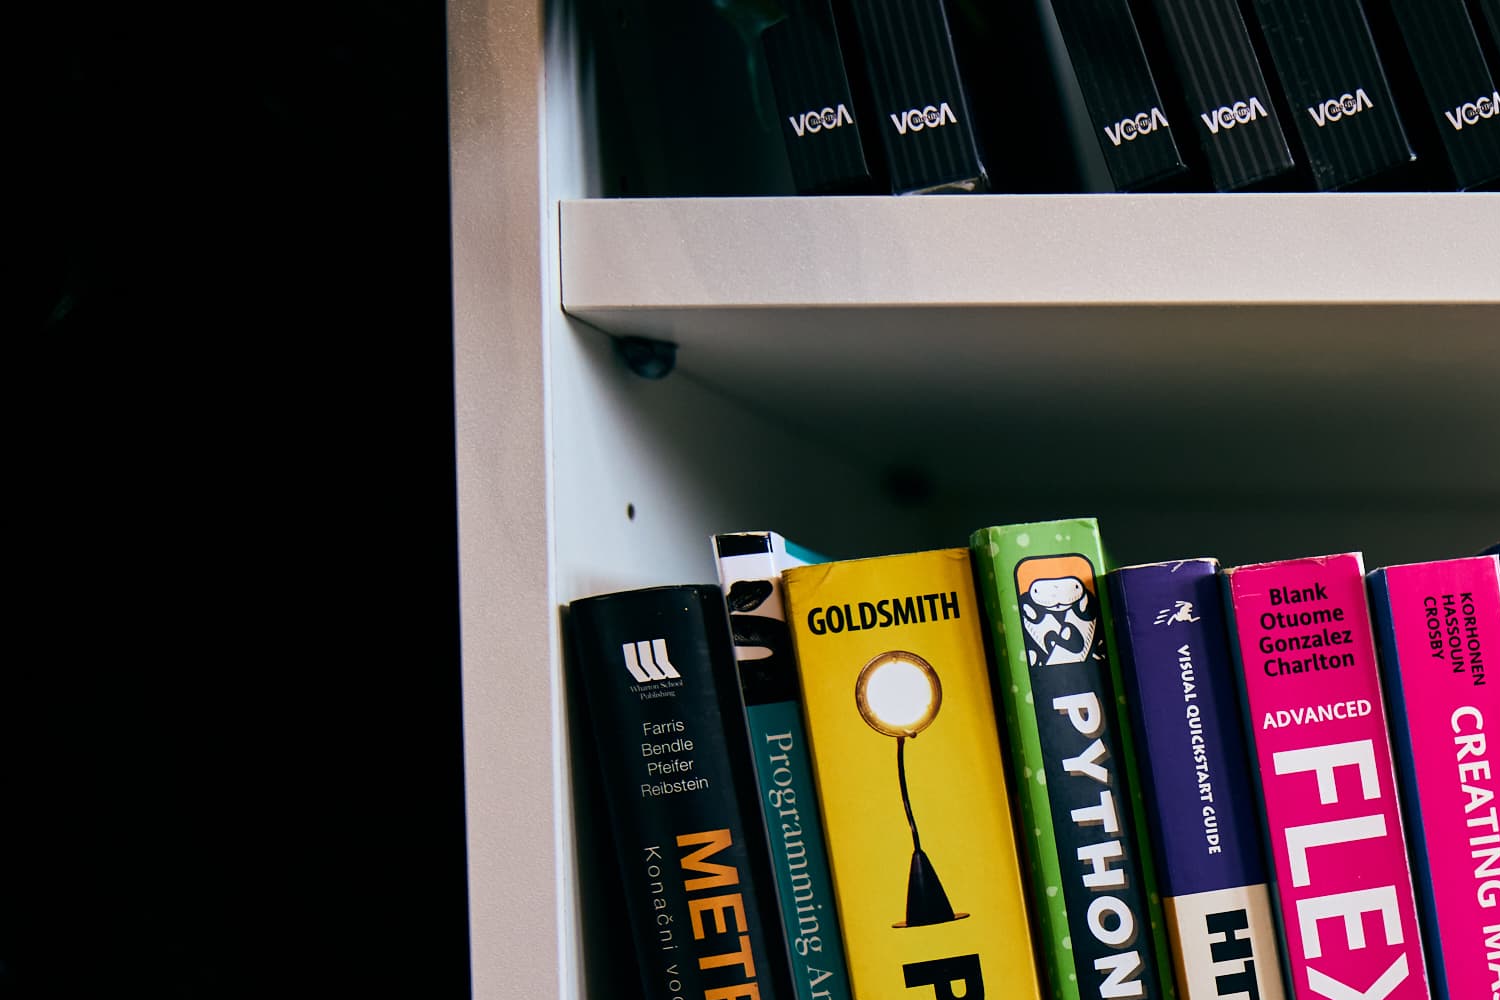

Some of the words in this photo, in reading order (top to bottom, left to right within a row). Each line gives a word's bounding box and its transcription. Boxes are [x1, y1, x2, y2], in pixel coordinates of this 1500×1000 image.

[807, 592, 960, 635] GOLDSMITH
[1269, 582, 1328, 606] Blank
[1259, 607, 1345, 631] Otuome
[1424, 596, 1445, 660] CROSBY
[1442, 594, 1465, 674] HASSOUN
[1460, 592, 1486, 687] KORHONEN
[1258, 628, 1353, 654] Gonzalez
[1177, 644, 1197, 702] VISUAL
[1263, 653, 1355, 678] Charlton
[643, 719, 685, 736] Farris
[1263, 699, 1372, 730] ADVANCED
[642, 739, 694, 757] Bendle
[647, 758, 694, 776] Pfeifer
[1186, 704, 1214, 803] QUICKSTART
[641, 776, 709, 798] Reibstein
[765, 730, 823, 956] Programming
[1053, 692, 1145, 999] PYTHON
[1202, 805, 1222, 855] GUIDE
[644, 846, 679, 950] Konačni
